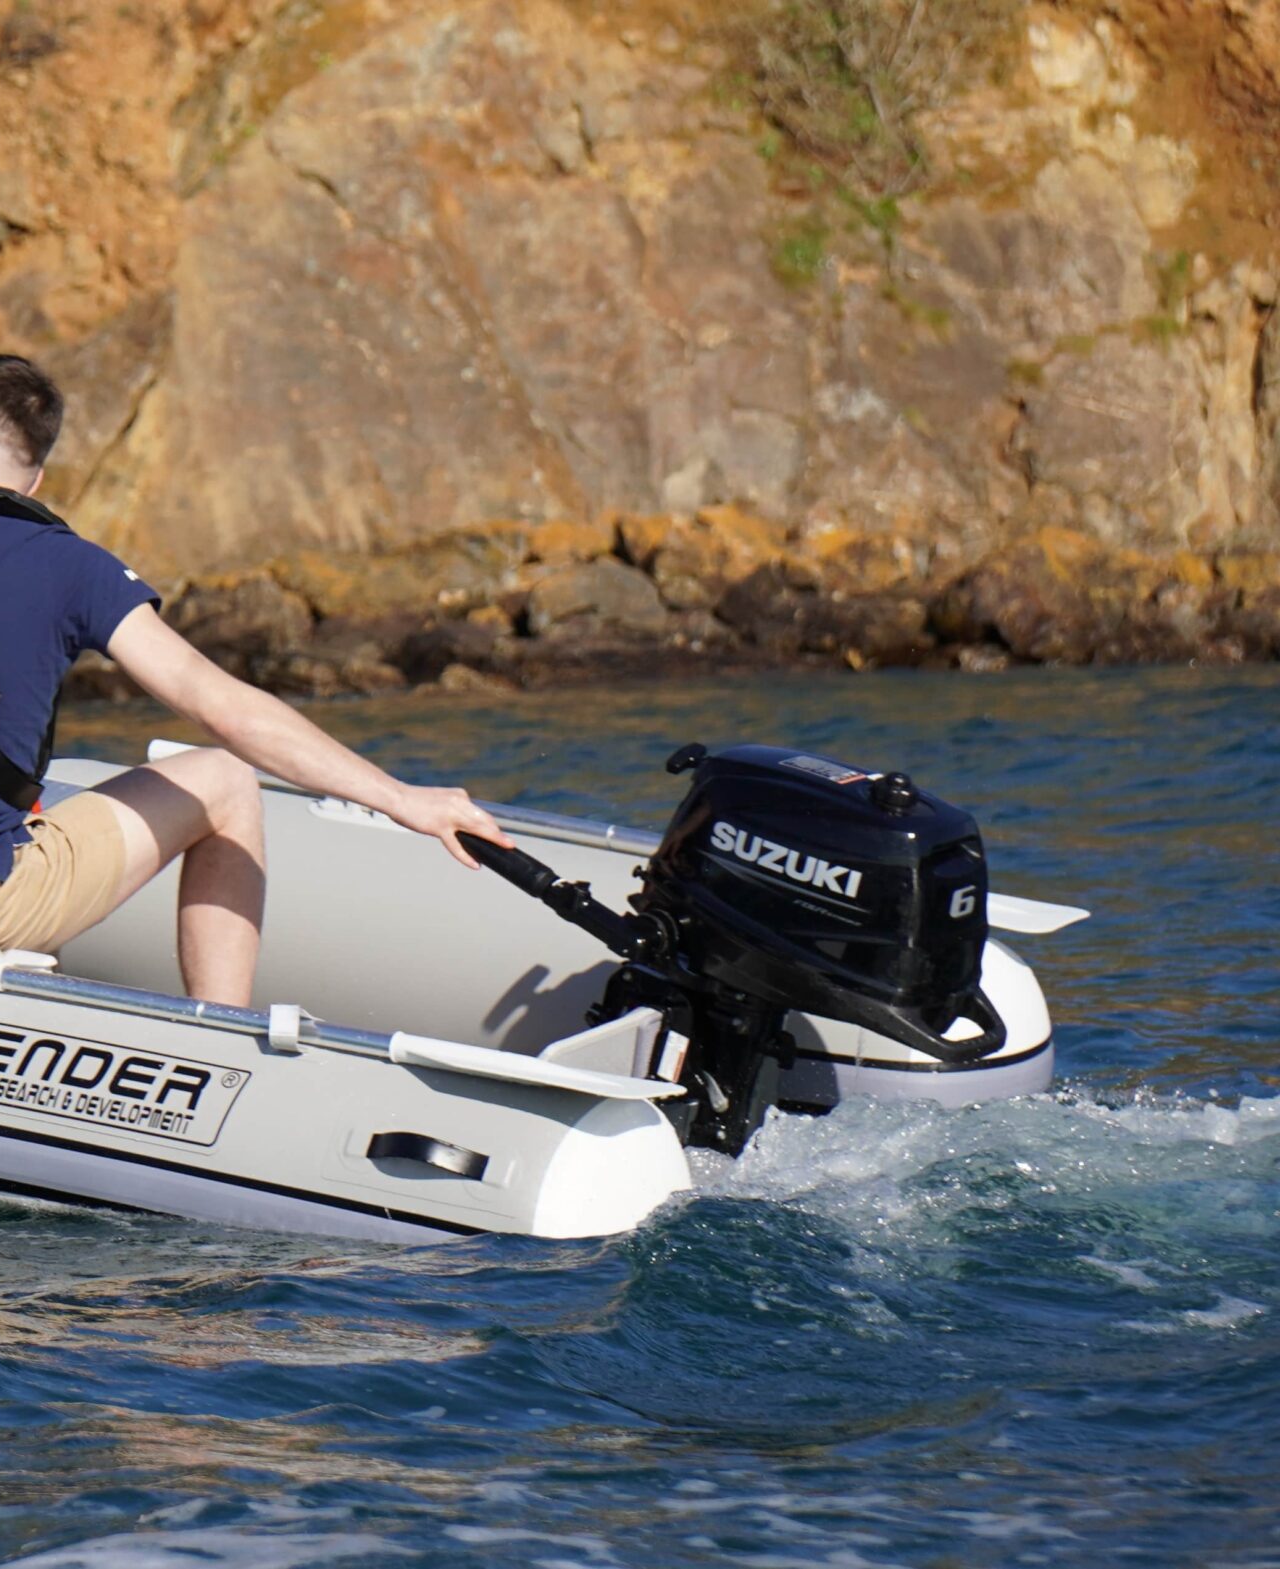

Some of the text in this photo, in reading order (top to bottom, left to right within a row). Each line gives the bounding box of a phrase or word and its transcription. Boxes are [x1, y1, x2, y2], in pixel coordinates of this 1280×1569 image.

[710, 821, 862, 898] SUZUKI
[948, 884, 976, 918] 6
[75, 1094, 194, 1134] DEVELOPMENT
